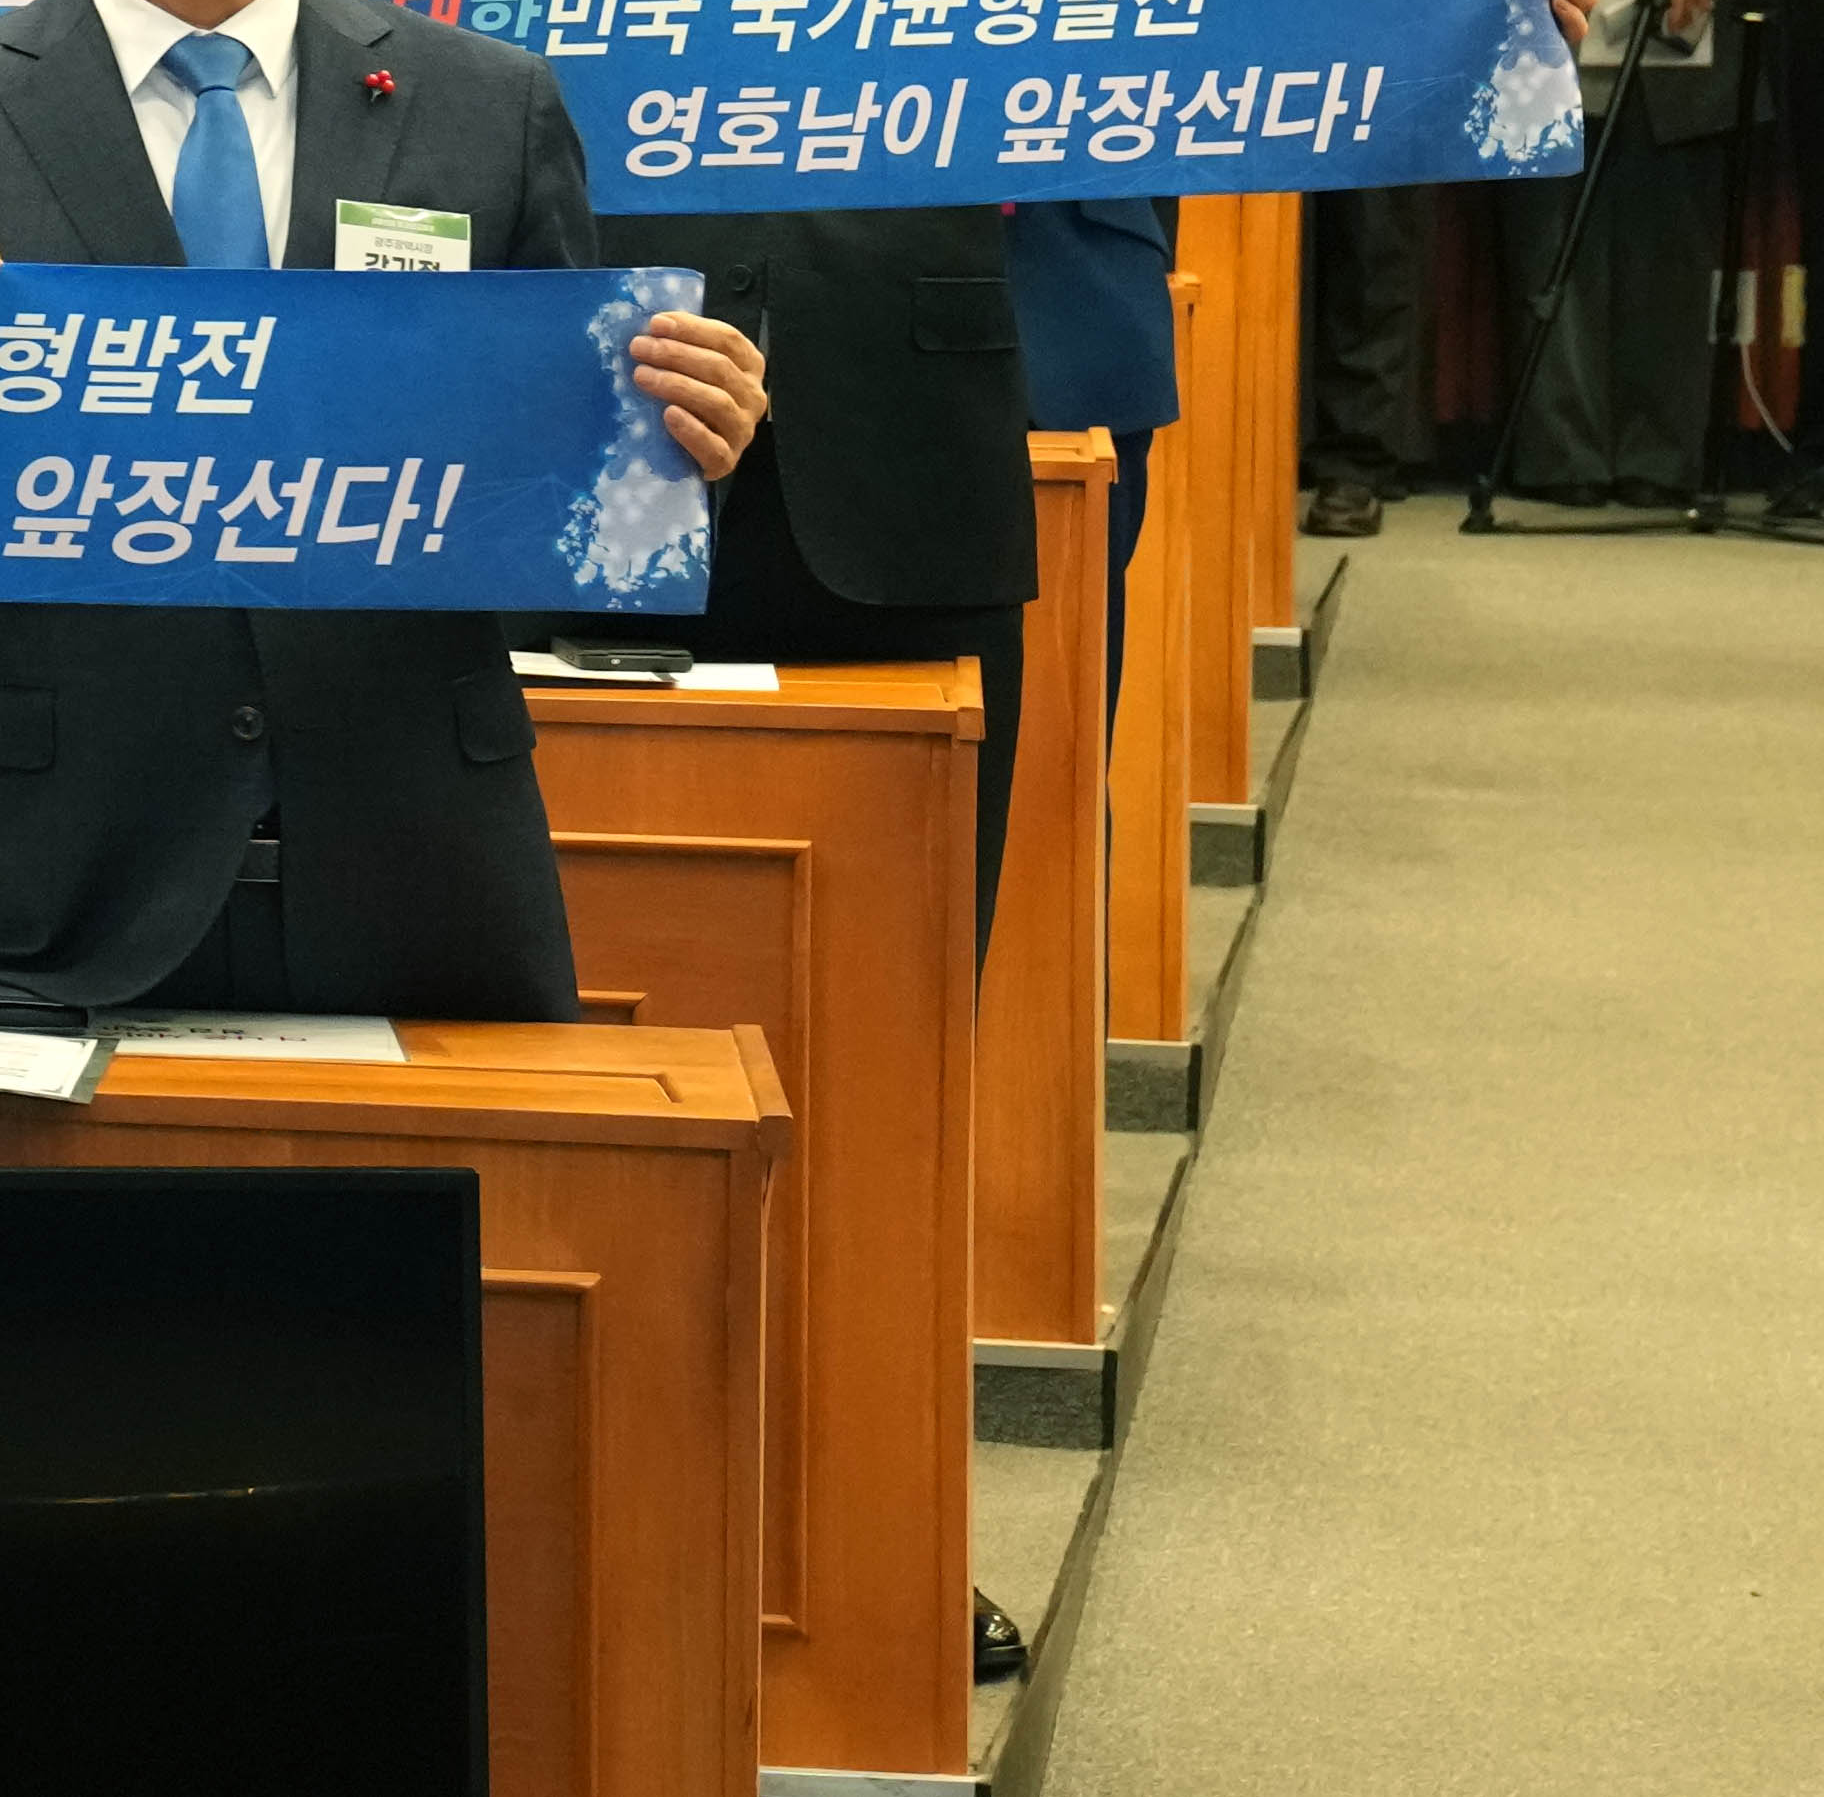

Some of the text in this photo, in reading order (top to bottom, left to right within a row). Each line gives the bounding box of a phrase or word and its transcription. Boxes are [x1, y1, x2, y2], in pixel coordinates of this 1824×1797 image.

[625, 61, 1385, 179] 영호남이 앞장선다!
[2, 454, 466, 567] 앞장선다!
